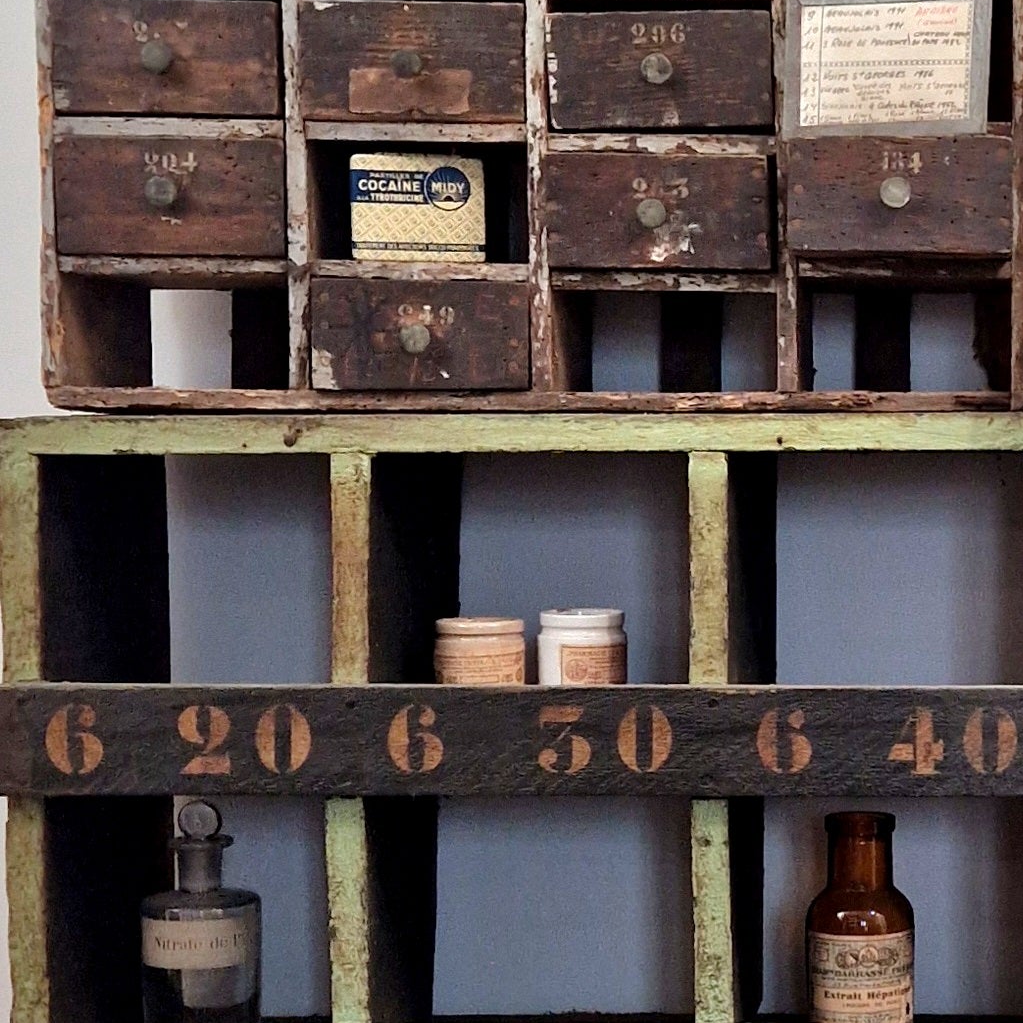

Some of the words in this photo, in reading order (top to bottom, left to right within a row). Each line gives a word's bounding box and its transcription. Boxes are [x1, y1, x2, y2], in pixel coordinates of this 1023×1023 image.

[431, 182, 465, 194] MIDY
[45, 706, 105, 775] 6
[177, 706, 312, 776] 20
[387, 709, 444, 774] 6
[538, 706, 672, 775] 30
[756, 712, 812, 774] 6
[888, 711, 1017, 776] 40
[824, 990, 862, 1000] Extrait
